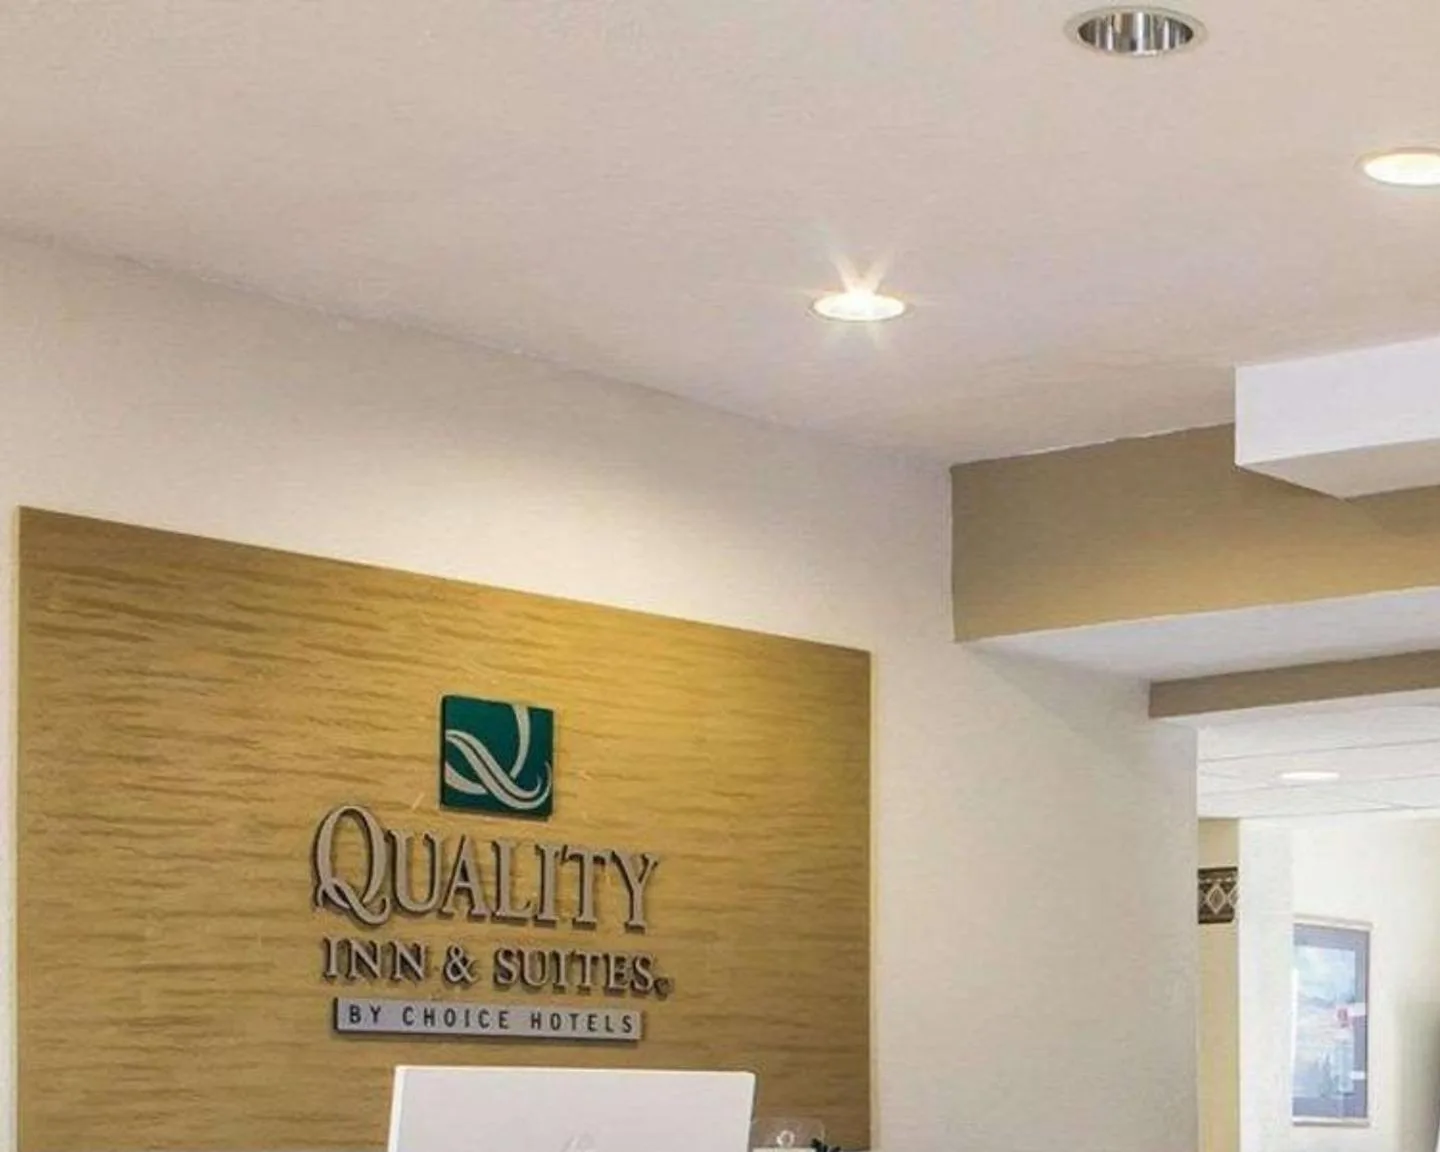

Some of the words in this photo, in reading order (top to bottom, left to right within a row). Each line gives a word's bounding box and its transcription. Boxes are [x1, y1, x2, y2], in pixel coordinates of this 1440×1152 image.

[314, 805, 659, 932] QUALITY
[323, 937, 428, 981] INN
[444, 942, 479, 986] &
[349, 1004, 382, 1025] BY
[402, 1006, 510, 1030] CHOICE
[530, 1010, 633, 1034] HOTELS
